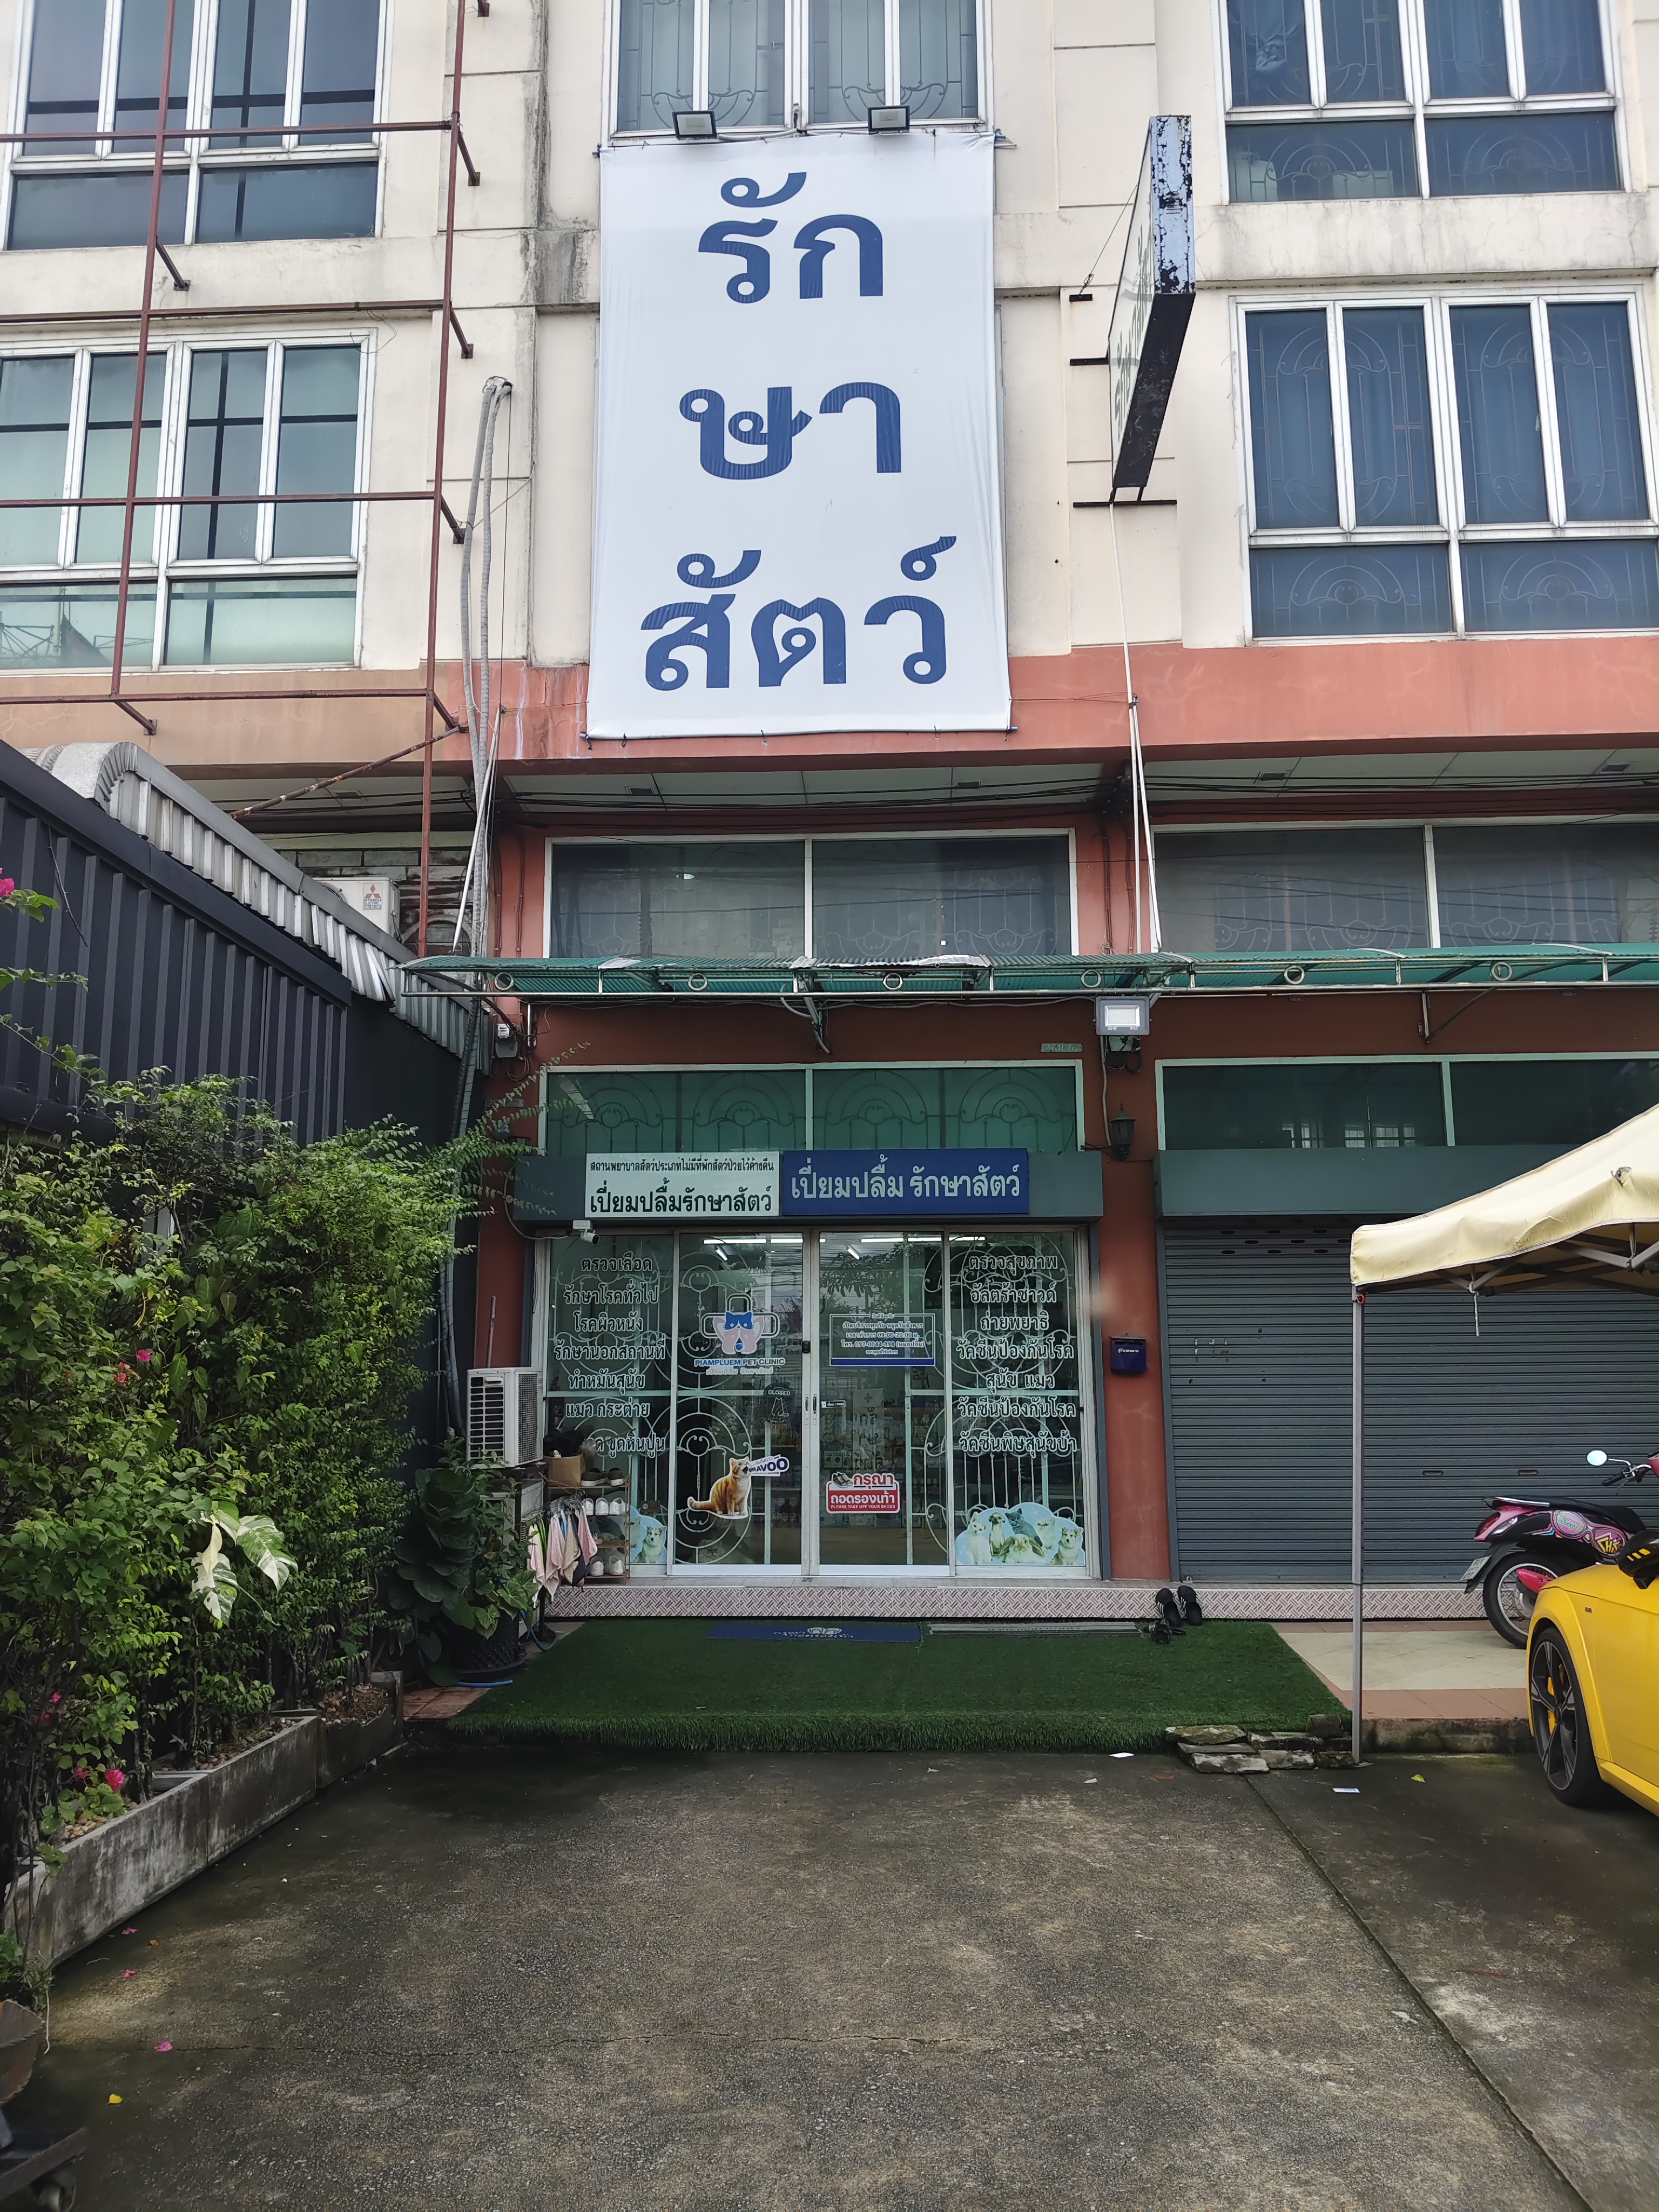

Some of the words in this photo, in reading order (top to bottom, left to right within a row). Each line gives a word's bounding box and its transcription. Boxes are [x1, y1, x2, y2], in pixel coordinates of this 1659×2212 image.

[698, 171, 883, 304] รัก
[679, 381, 901, 480] ษา
[640, 536, 956, 691] สัตว์
[590, 1156, 774, 1172] สถานพยาบาลสัตว์ประเภทไม่มีที่พักสัตว์ป่วยไว้ค้างคืน
[792, 1154, 903, 1199] เปี่ยมปลื้ม
[909, 1164, 1021, 1199] รักษาสัตว์
[590, 1177, 772, 1213] เปี่ยมปลื้มรักษาสัตว์
[581, 1252, 652, 1272] ตรวจเลือด
[969, 1254, 1058, 1276] ตรวจสุขภาพ
[563, 1279, 658, 1305] รักษาโรคทั่วไป
[970, 1282, 1057, 1304] อัลตร้าซาวด์
[574, 1311, 643, 1332] โรคผิวหนัง
[842, 1321, 886, 1331] เปิดบริการทุกวัน
[886, 1321, 923, 1330] หยุดวันอังคาร
[981, 1310, 1049, 1331] ถ่ายพยาธิ
[555, 1334, 665, 1360] รักษานอกสถานที่
[841, 1339, 854, 1347] โทร.
[956, 1336, 1074, 1360] วัคซีนป้องกันโรค
[569, 1370, 645, 1394] ทำหมันสุนัข
[986, 1368, 1019, 1394] สุนัข
[1024, 1373, 1055, 1388] แมว
[566, 1402, 593, 1418] แมว
[597, 1397, 650, 1418] กระต่าย
[957, 1395, 1076, 1418] วัคซีนป้องกันโรค
[608, 1432, 665, 1458] ขูดหินปูน
[959, 1429, 1077, 1458] วัคซีนพิษสุนัขบ้า
[749, 1458, 788, 1473] BRAVOO
[854, 1474, 893, 1489] กรุณา
[831, 1491, 895, 1504] ถอดรองเท้า
